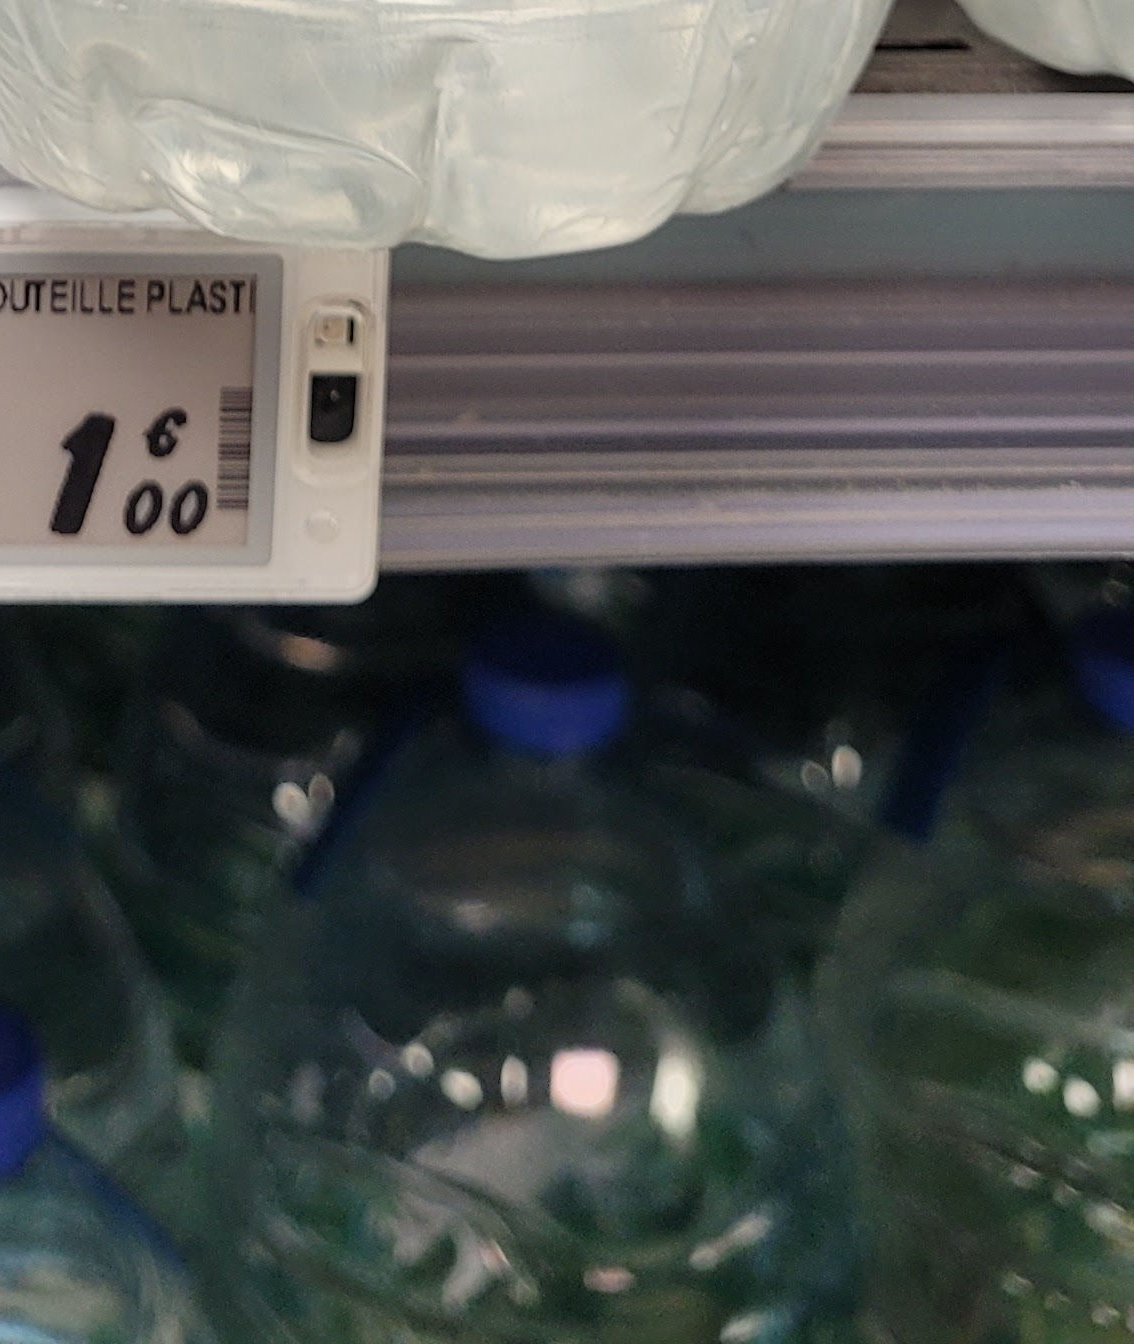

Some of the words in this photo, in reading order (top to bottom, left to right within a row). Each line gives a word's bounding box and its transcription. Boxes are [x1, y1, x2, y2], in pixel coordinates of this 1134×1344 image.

[147, 278, 256, 314] PLASTI
[49, 410, 116, 535] 1
[124, 478, 209, 536] 00
